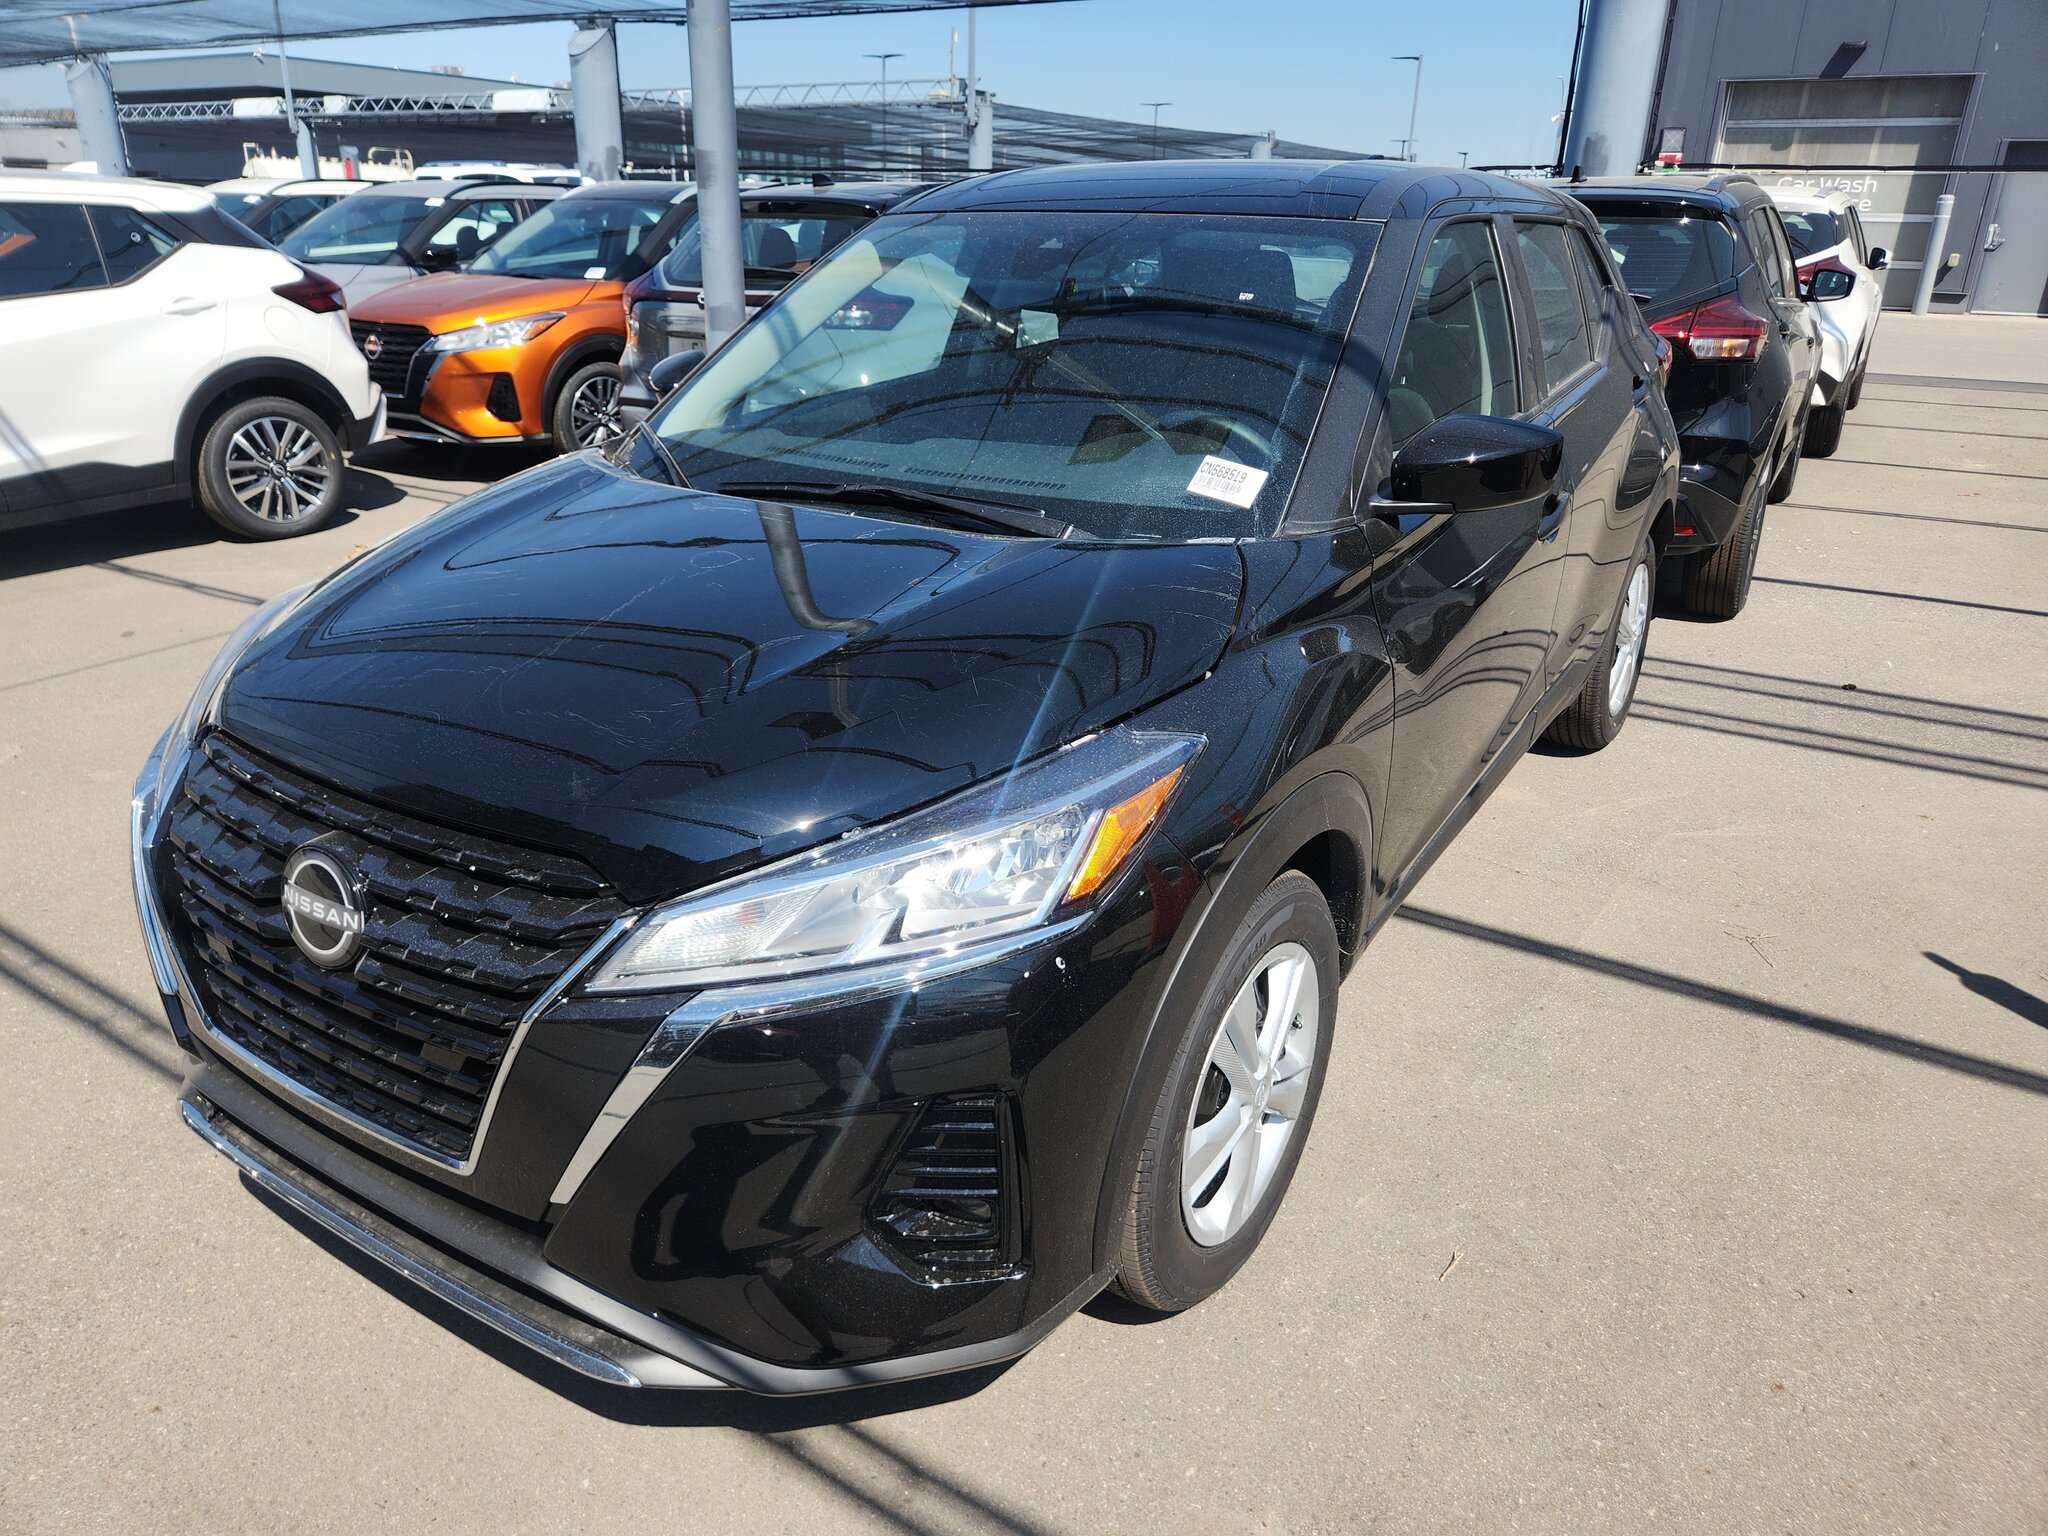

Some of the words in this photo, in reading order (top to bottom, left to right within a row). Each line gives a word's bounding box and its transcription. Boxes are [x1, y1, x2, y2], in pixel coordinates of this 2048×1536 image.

[1777, 177, 1815, 187] Car
[1820, 176, 1878, 193] Wash
[1200, 461, 1248, 484] CN568519
[284, 884, 359, 930] NISSAN
